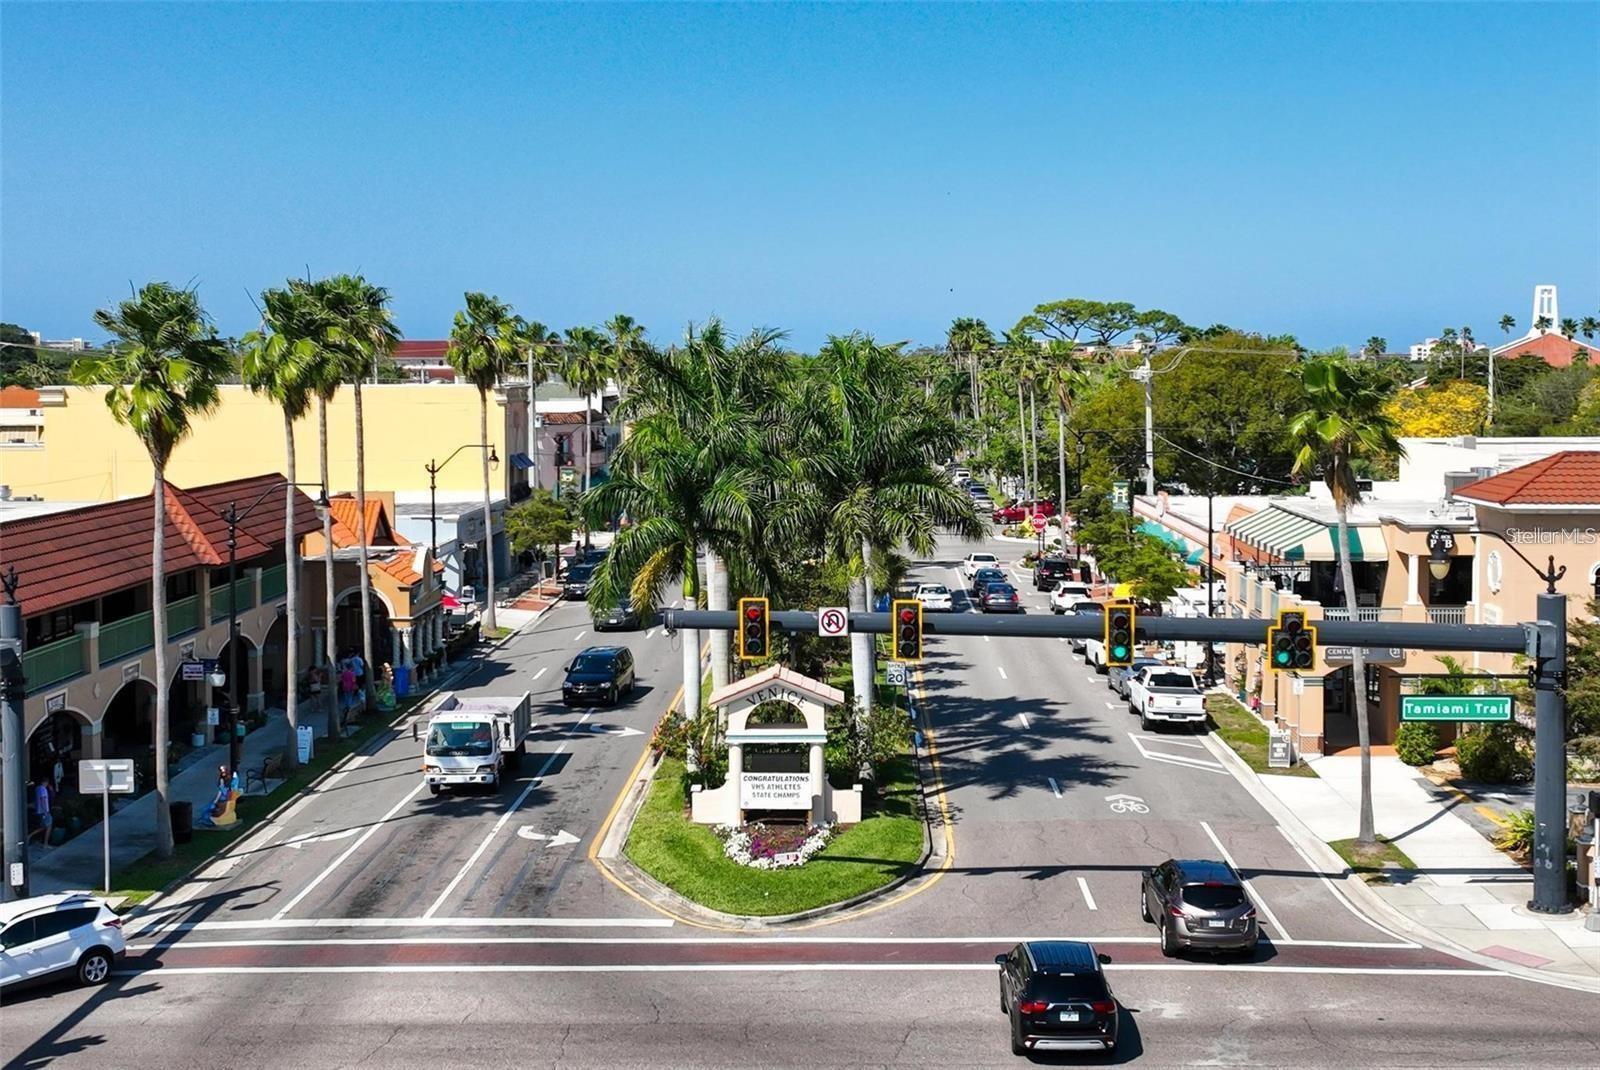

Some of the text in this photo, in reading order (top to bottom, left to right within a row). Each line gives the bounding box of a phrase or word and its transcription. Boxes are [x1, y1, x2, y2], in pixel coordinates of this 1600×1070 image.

[1430, 539, 1453, 548] PB
[888, 673, 903, 683] 20
[746, 687, 808, 708] VENICE
[1405, 703, 1509, 714] Tamiami Trail
